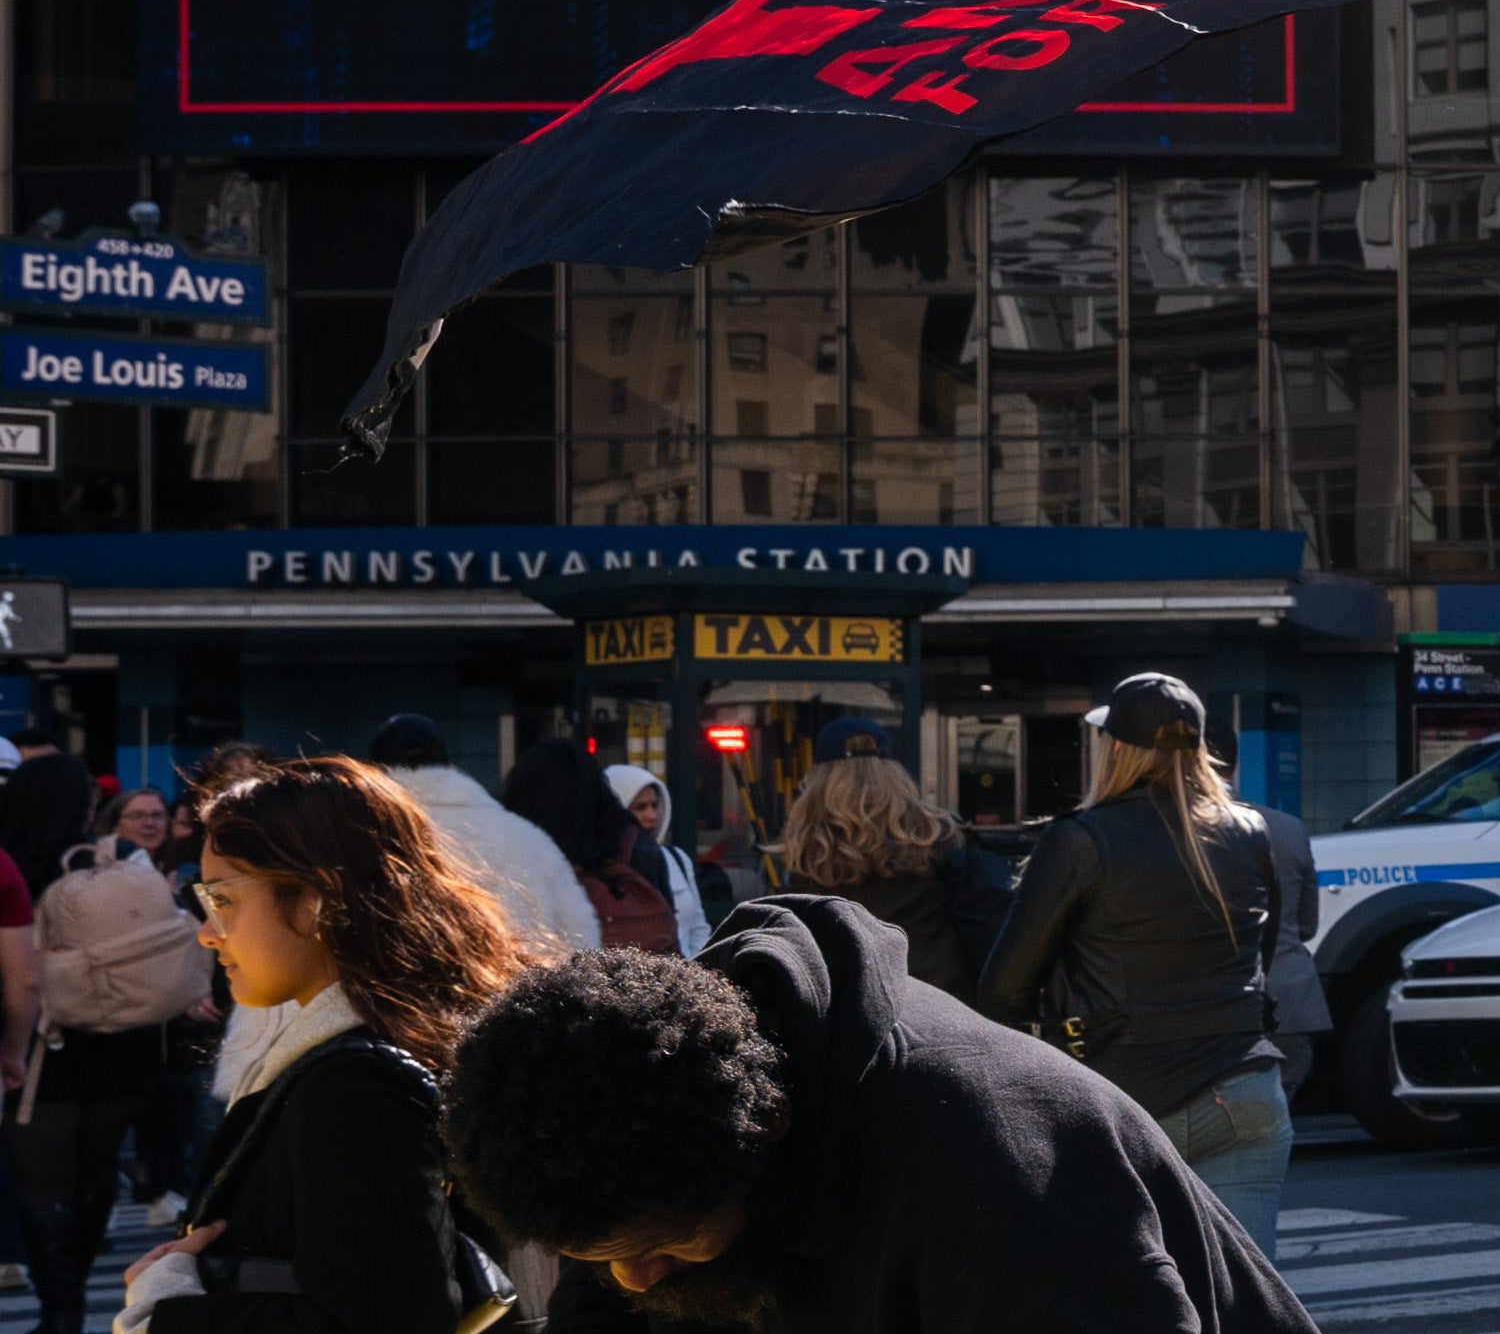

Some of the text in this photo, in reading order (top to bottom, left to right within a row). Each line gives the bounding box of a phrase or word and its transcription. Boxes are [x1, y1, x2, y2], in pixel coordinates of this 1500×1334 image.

[21, 252, 245, 306] Eighth Ave
[22, 346, 248, 390] Joe Louis Plaza
[245, 542, 976, 585] PENNSYLVANIA STATION
[590, 616, 832, 659] TAXI TAXI
[1430, 650, 1464, 664] Street
[1444, 662, 1485, 675] Station
[1418, 677, 1429, 690] A
[1345, 866, 1415, 884] POLICE
